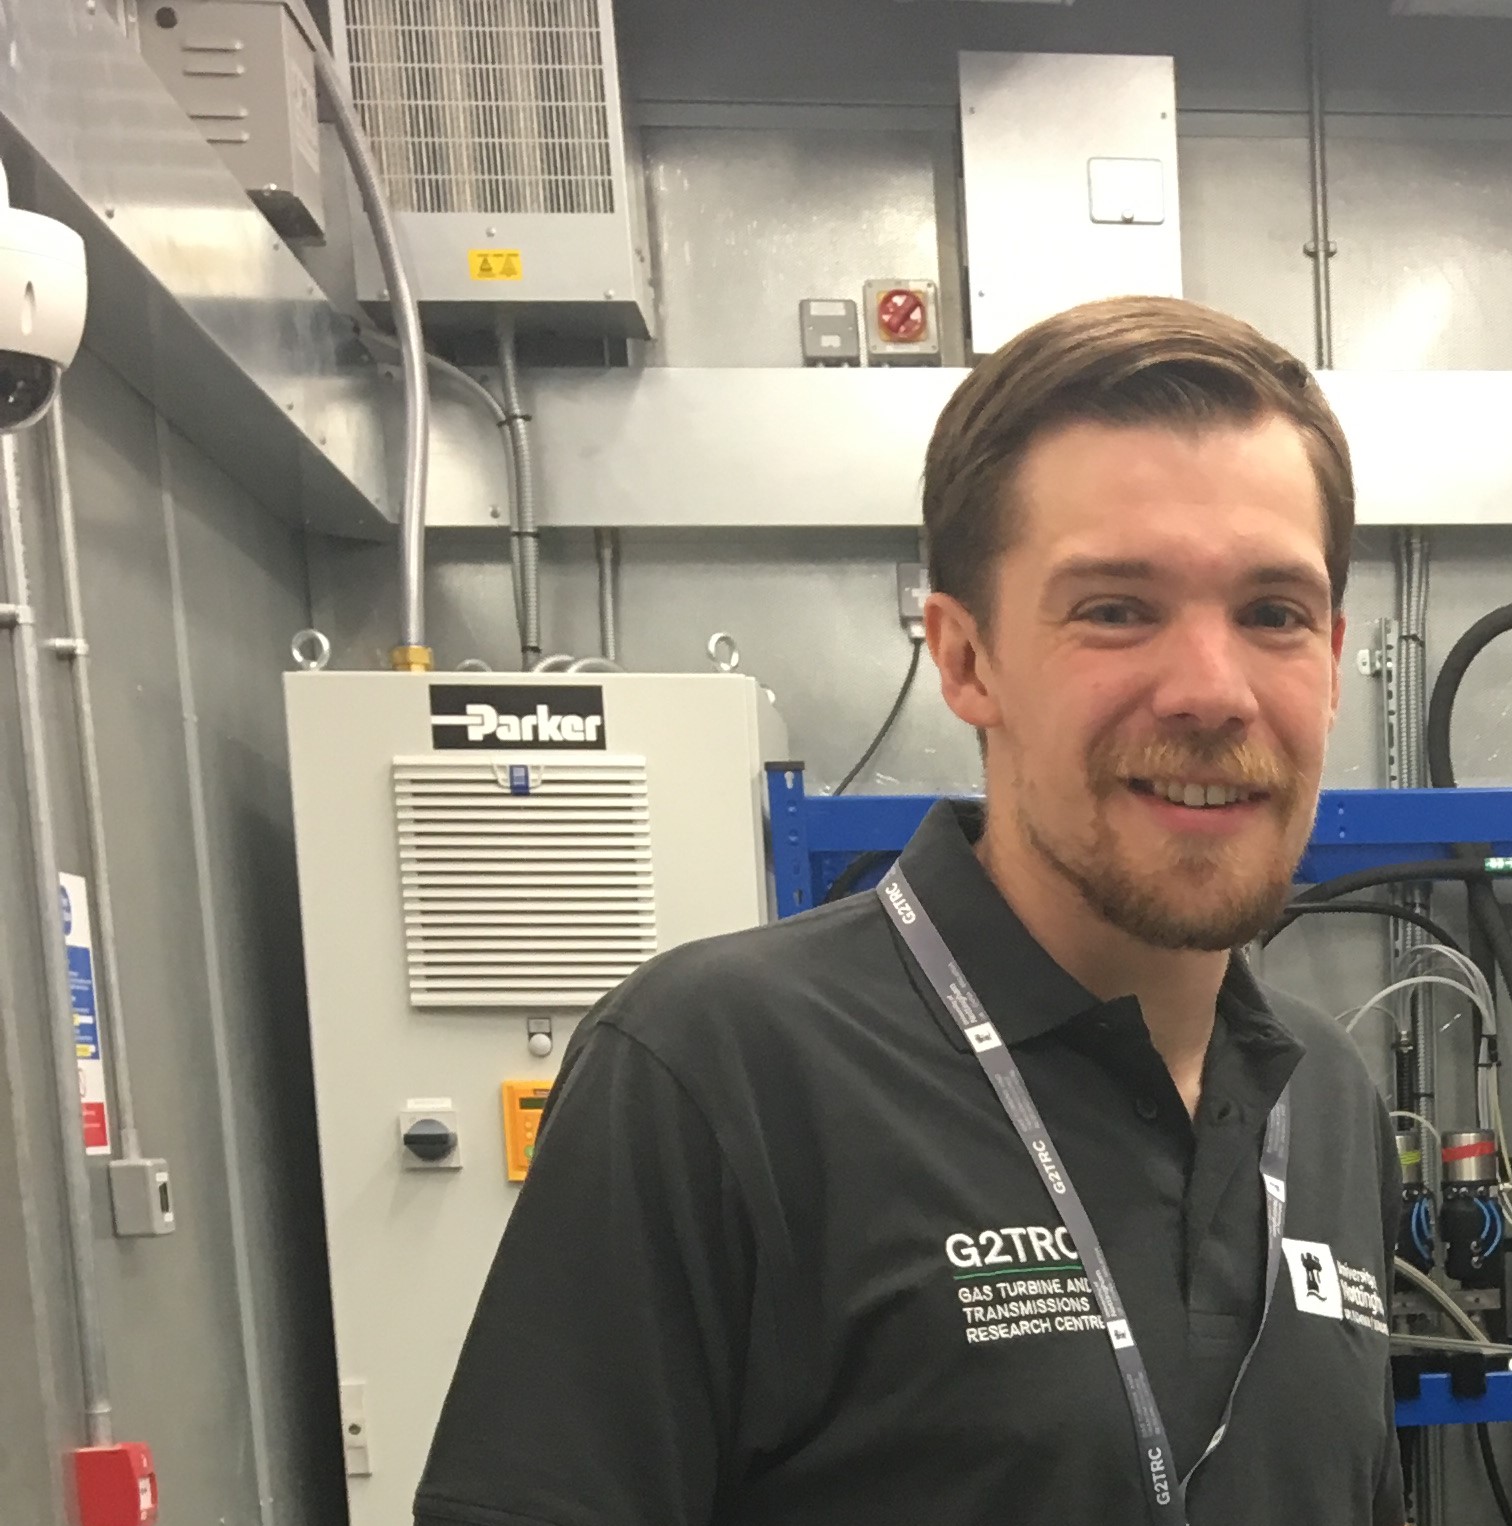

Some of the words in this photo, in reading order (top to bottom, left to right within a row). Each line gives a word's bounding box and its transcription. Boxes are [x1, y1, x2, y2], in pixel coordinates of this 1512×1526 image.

[465, 704, 602, 742] Parker
[885, 882, 917, 925] G2TRC
[1032, 1139, 1067, 1195] G2TRC
[958, 1285, 994, 1303] GAS
[996, 1279, 1064, 1299] TURBINE
[962, 1297, 1091, 1324] TRANSMISSIONS
[966, 1318, 1053, 1344] RESEARCH
[1147, 1446, 1171, 1505] G2TRC
